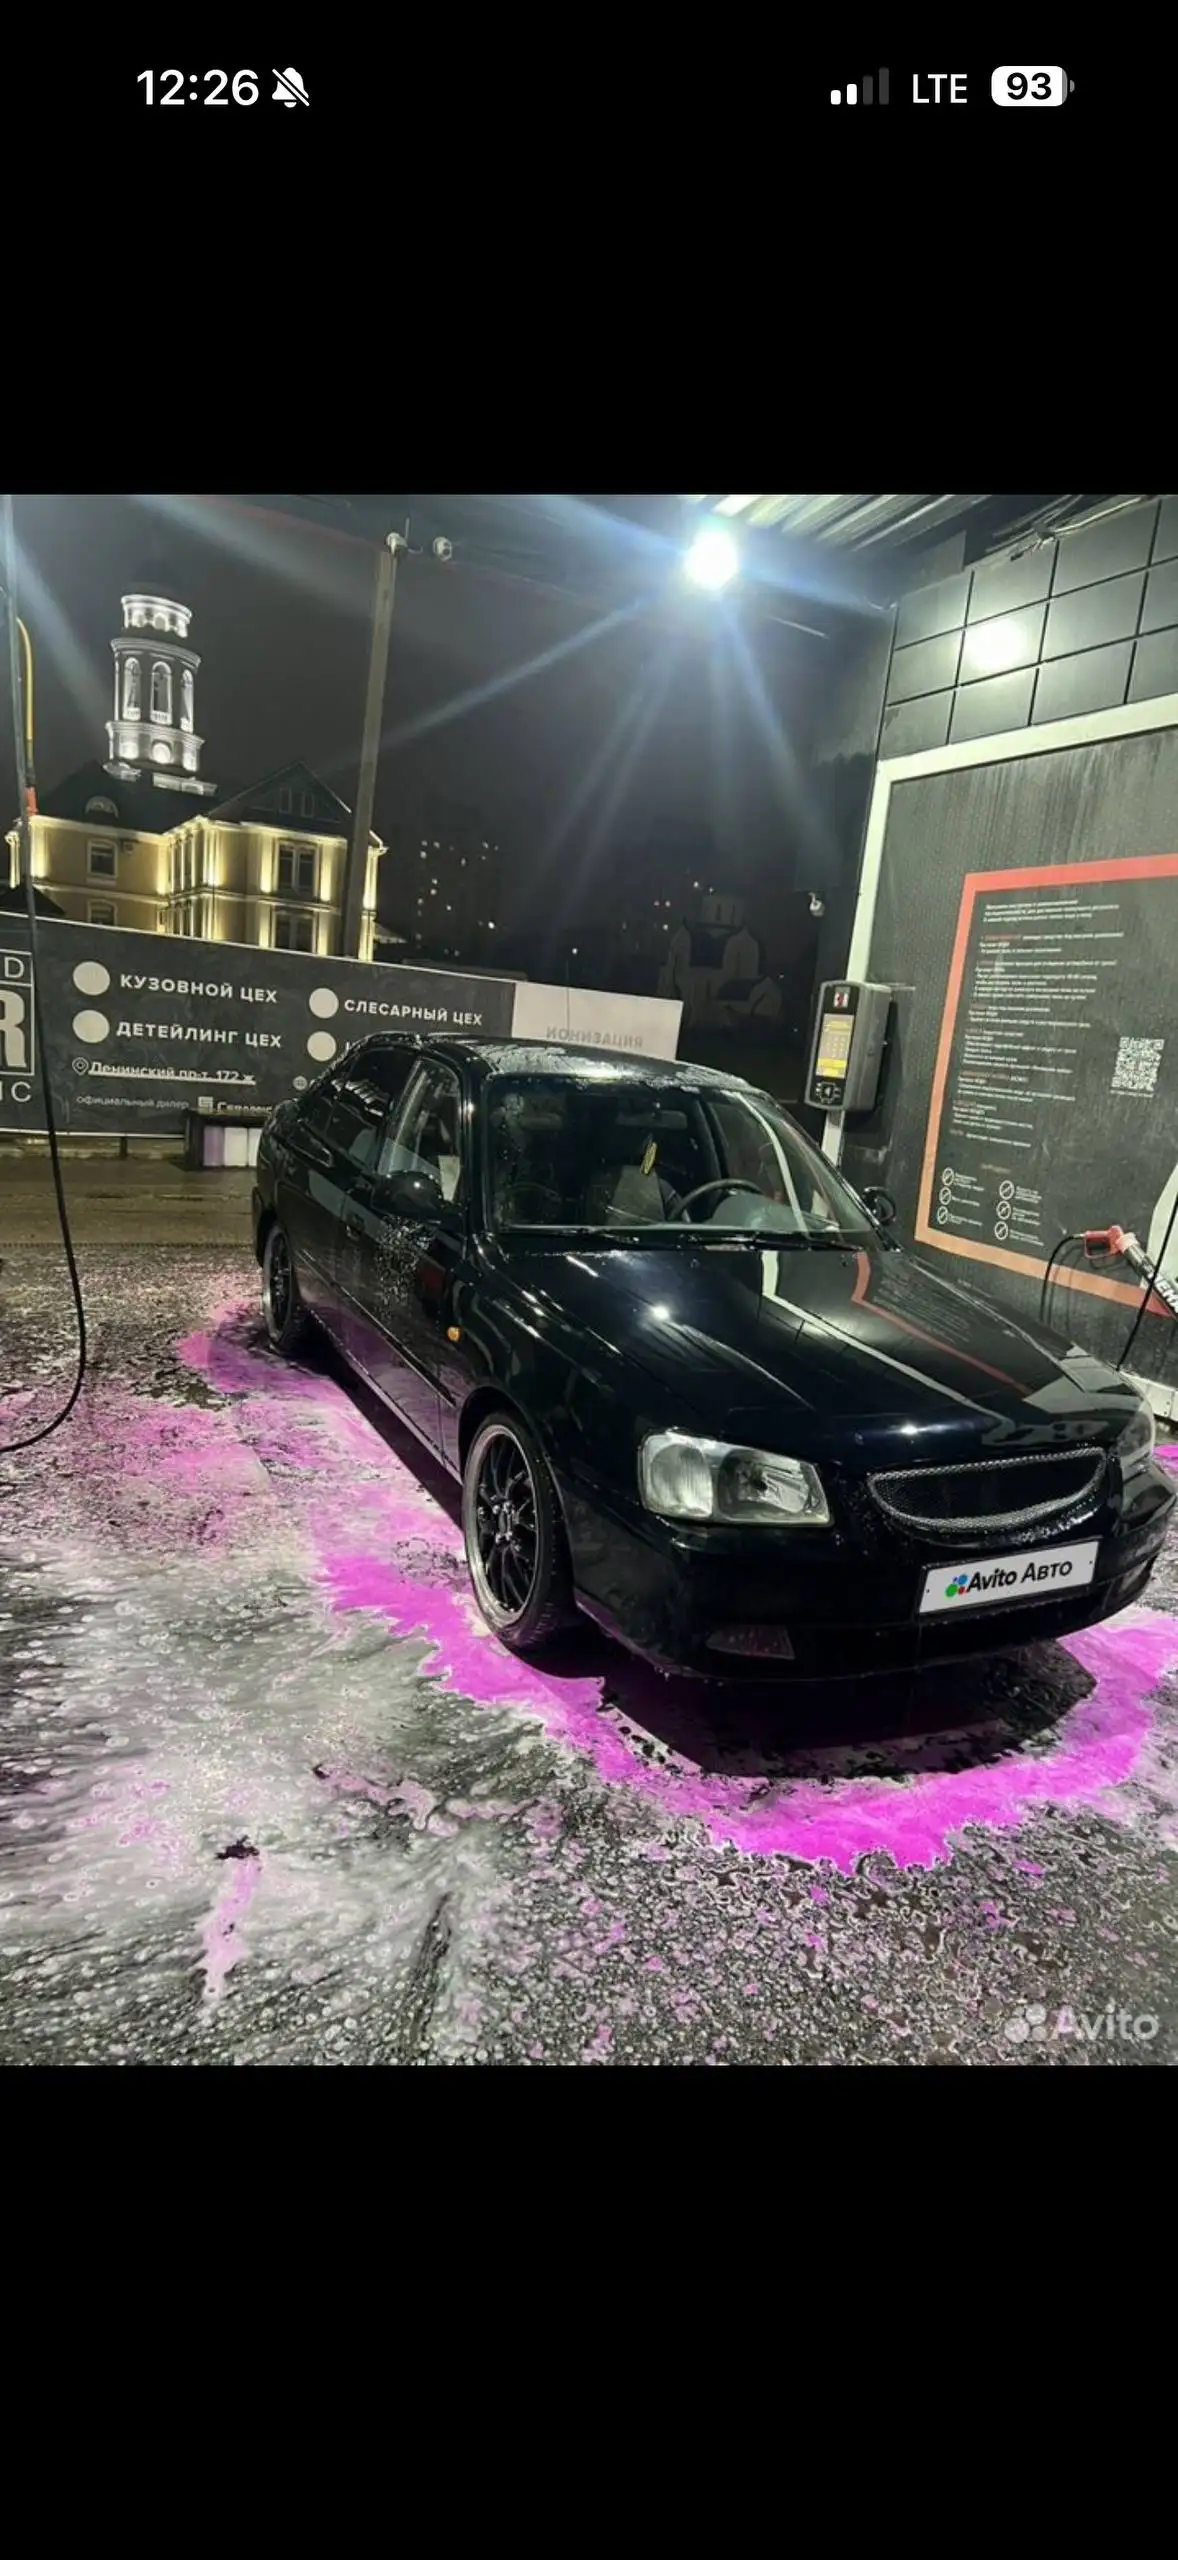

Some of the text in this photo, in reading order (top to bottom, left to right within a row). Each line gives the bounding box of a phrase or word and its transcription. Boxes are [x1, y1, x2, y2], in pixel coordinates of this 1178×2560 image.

[120, 973, 278, 1003] КУЗОВНОЙ ЦЕХ
[343, 999, 483, 1026] СЛЕСАРНЫЙ ЦЕХ
[115, 1021, 282, 1049] ДЕТЕЙЛИНГ ЦЕХ
[89, 1061, 175, 1079] Ленинский
[216, 1069, 239, 1082] 172
[76, 1095, 189, 1110] официальный дилер
